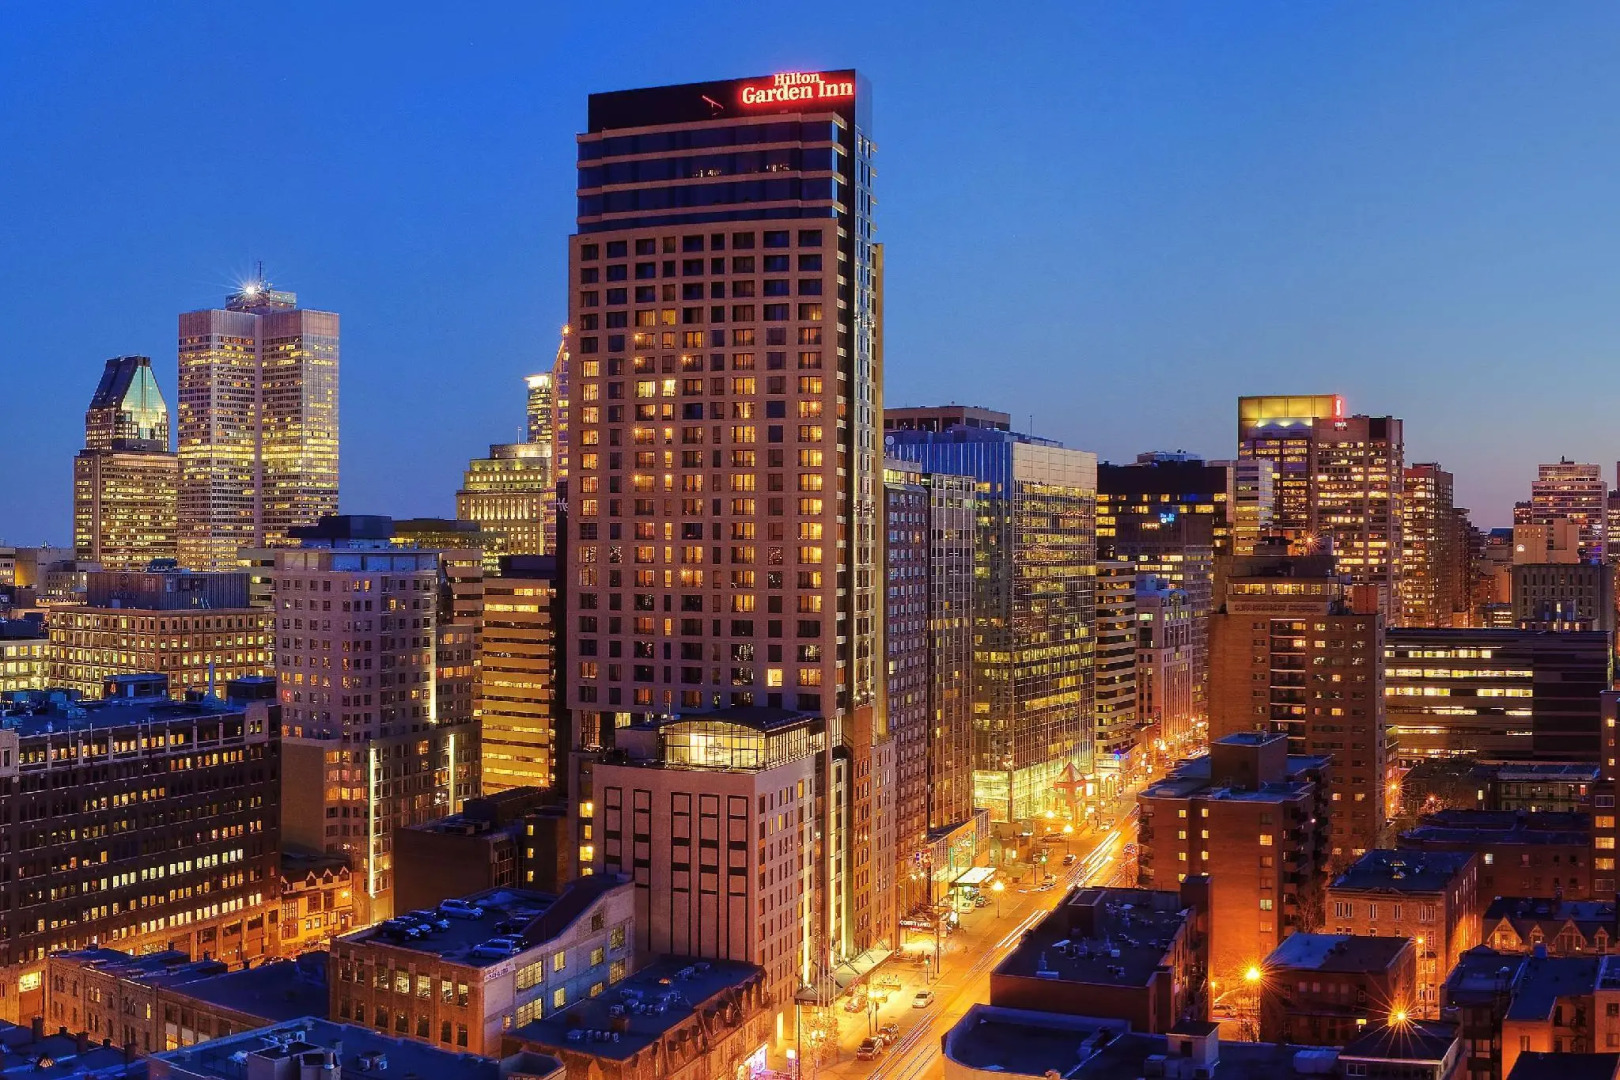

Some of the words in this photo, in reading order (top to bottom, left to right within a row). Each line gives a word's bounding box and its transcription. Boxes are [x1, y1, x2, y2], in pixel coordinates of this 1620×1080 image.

[774, 72, 820, 87] Hilton
[742, 84, 813, 104] Garden
[818, 80, 853, 97] Inn
